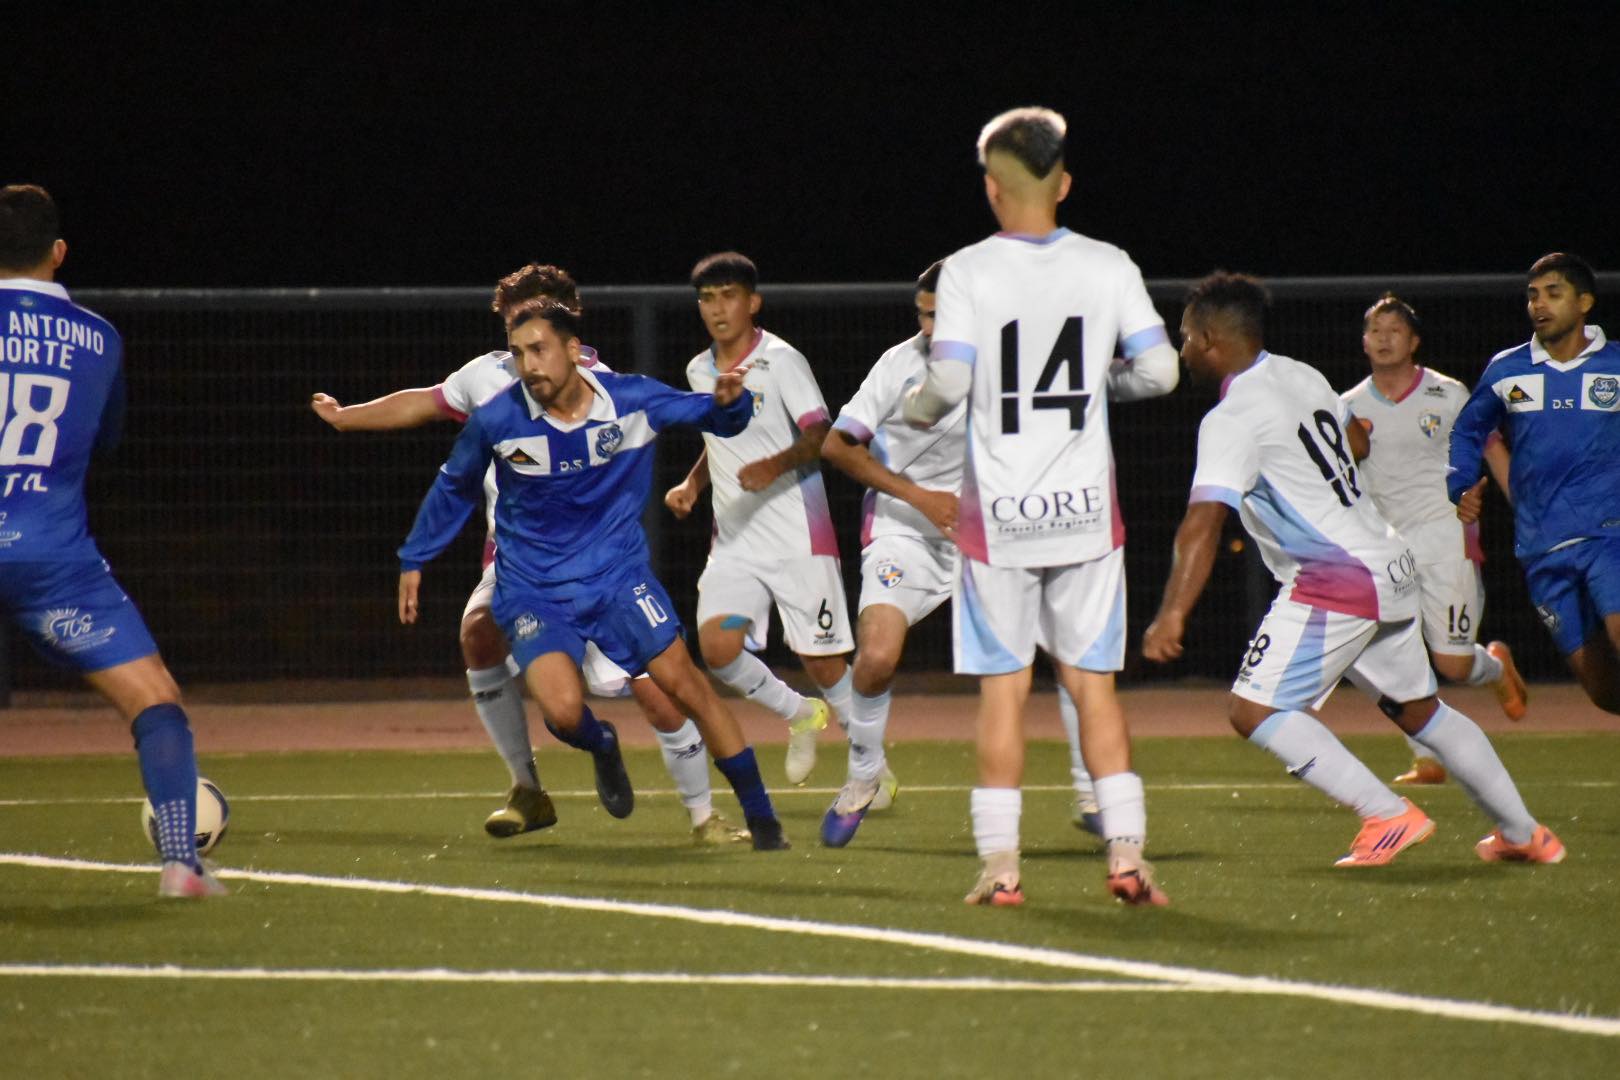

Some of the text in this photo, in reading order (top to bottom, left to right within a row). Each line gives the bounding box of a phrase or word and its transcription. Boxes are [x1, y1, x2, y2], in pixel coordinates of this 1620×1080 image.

[9, 311, 104, 355] ANTONIO
[1001, 316, 1091, 435] 14
[1297, 408, 1361, 508] 18
[991, 487, 1103, 523] CORE
[636, 594, 668, 628] 10
[818, 598, 833, 630] 6
[1449, 604, 1470, 633] 16
